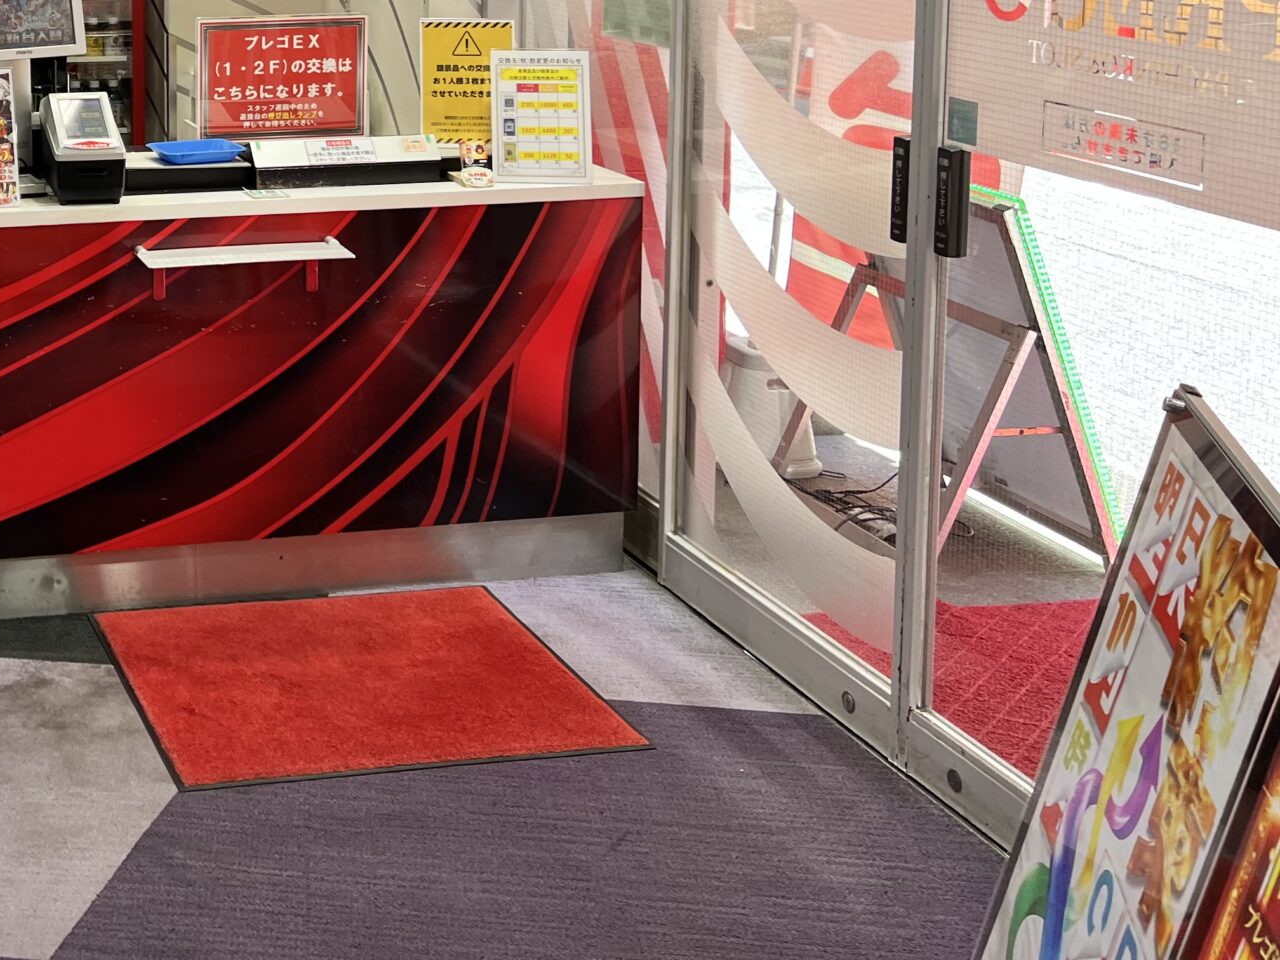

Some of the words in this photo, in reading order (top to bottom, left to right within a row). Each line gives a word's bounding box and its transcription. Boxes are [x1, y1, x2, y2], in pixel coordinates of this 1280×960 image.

[244, 34, 320, 51] プレゴEX
[213, 82, 343, 101] こちらになります。
